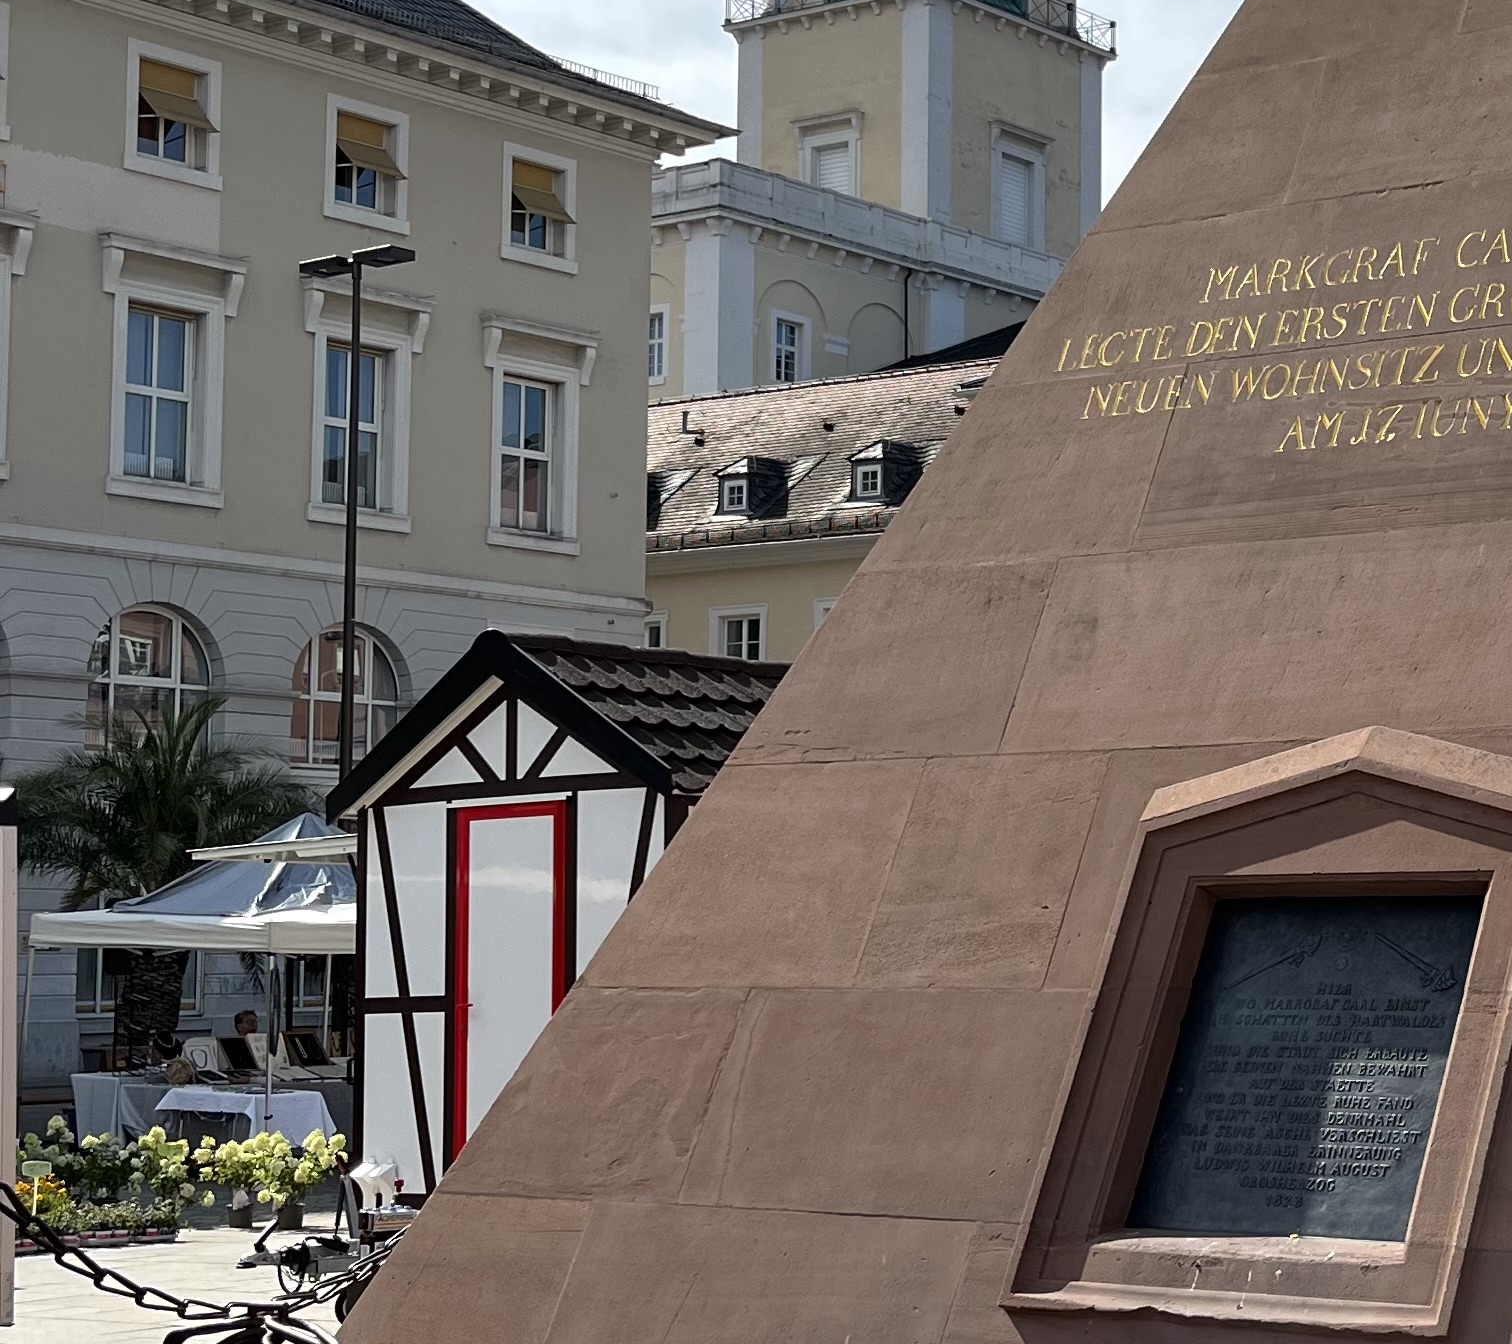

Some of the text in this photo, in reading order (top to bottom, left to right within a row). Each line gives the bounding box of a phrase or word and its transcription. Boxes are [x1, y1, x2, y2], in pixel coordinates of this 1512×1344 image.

[1199, 237, 1440, 303] MARKGRAF
[1181, 312, 1266, 357] DEN
[1273, 291, 1440, 346] ERSTEN
[1080, 369, 1221, 420] NEUEN
[1230, 344, 1446, 403] WOHNSITZ
[1273, 410, 1346, 453] AM
[1316, 983, 1352, 996] HIER
[1263, 998, 1340, 1011] MARKGRAF
[1341, 998, 1377, 1011] CARL
[1384, 998, 1431, 1012] EINST
[1235, 1014, 1309, 1027] SCHATTEN
[1316, 1015, 1341, 1027] DES
[1350, 1014, 1447, 1029] HARTWALDES
[1272, 1030, 1373, 1044] RUHE SUCHTE
[1247, 1046, 1270, 1058] DIE
[1276, 1046, 1321, 1059] STADT
[1328, 1047, 1360, 1060] SICH
[1365, 1047, 1429, 1062] ERBAUTE
[1232, 1061, 1283, 1074] SEINEN
[1291, 1062, 1351, 1076] NAHMEN
[1357, 1062, 1429, 1079] BEWAHRT
[1249, 1078, 1376, 1093] AUF DER STAETTE
[1204, 1092, 1415, 1111] WO ER DIE LEZTE RUHE FAND
[1205, 1107, 1251, 1123] WEIHT
[1287, 1112, 1321, 1125] DIES
[1326, 1111, 1407, 1128] DENKMAHL
[1214, 1125, 1255, 1139] SEINE
[1263, 1126, 1312, 1141] ASCHE
[1320, 1127, 1421, 1145] VERSCHLIEST
[1191, 1140, 1403, 1162] IN DANKBARER ERINNERUNG
[1193, 1157, 1392, 1179] LUDWIG WILHELM AUGUST
[1239, 1176, 1336, 1193] GROSHERZOG
